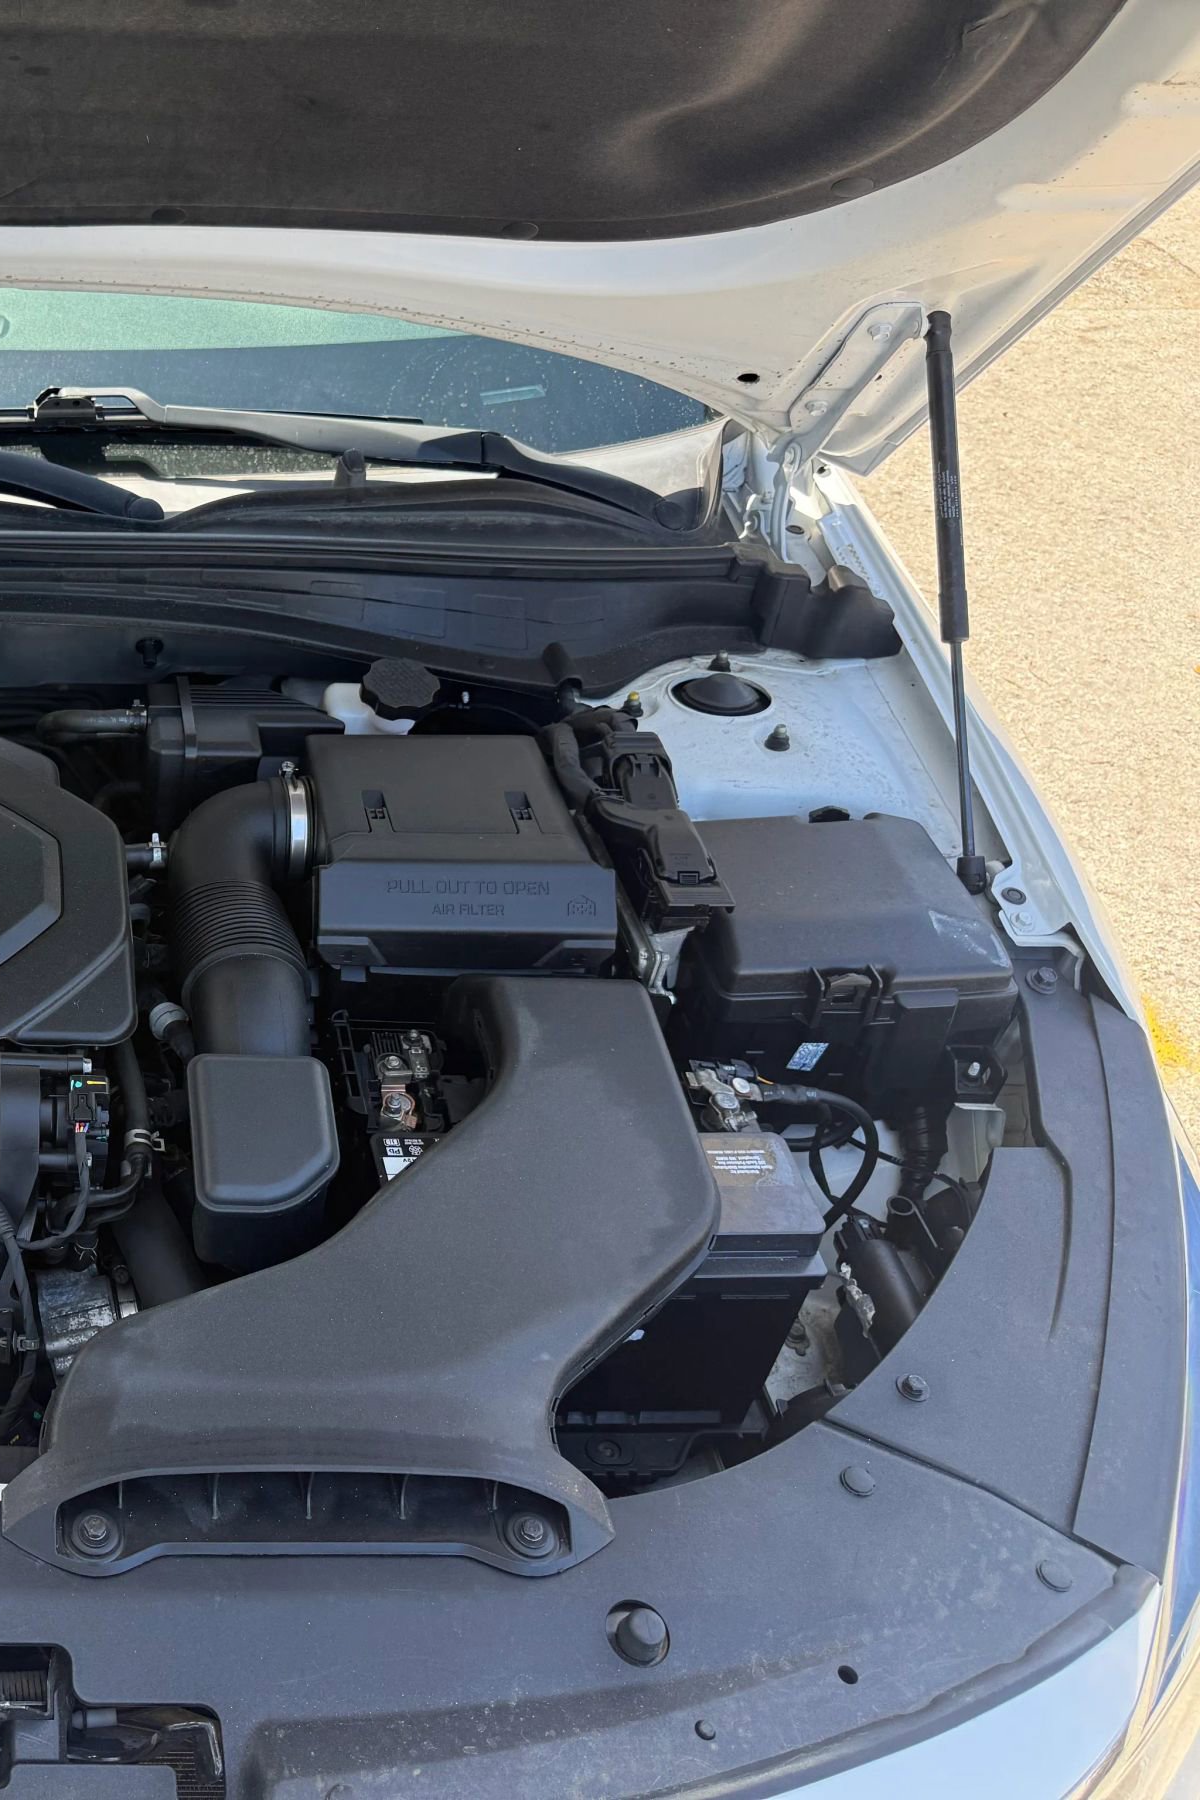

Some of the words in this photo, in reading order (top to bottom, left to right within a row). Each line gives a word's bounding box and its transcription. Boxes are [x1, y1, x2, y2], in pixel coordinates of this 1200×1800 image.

[386, 880, 431, 894] PULL
[436, 880, 469, 895] OUT
[473, 880, 498, 895] TO
[503, 880, 550, 896] OPEN
[431, 903, 455, 916] AIR
[458, 903, 505, 917] FILTER
